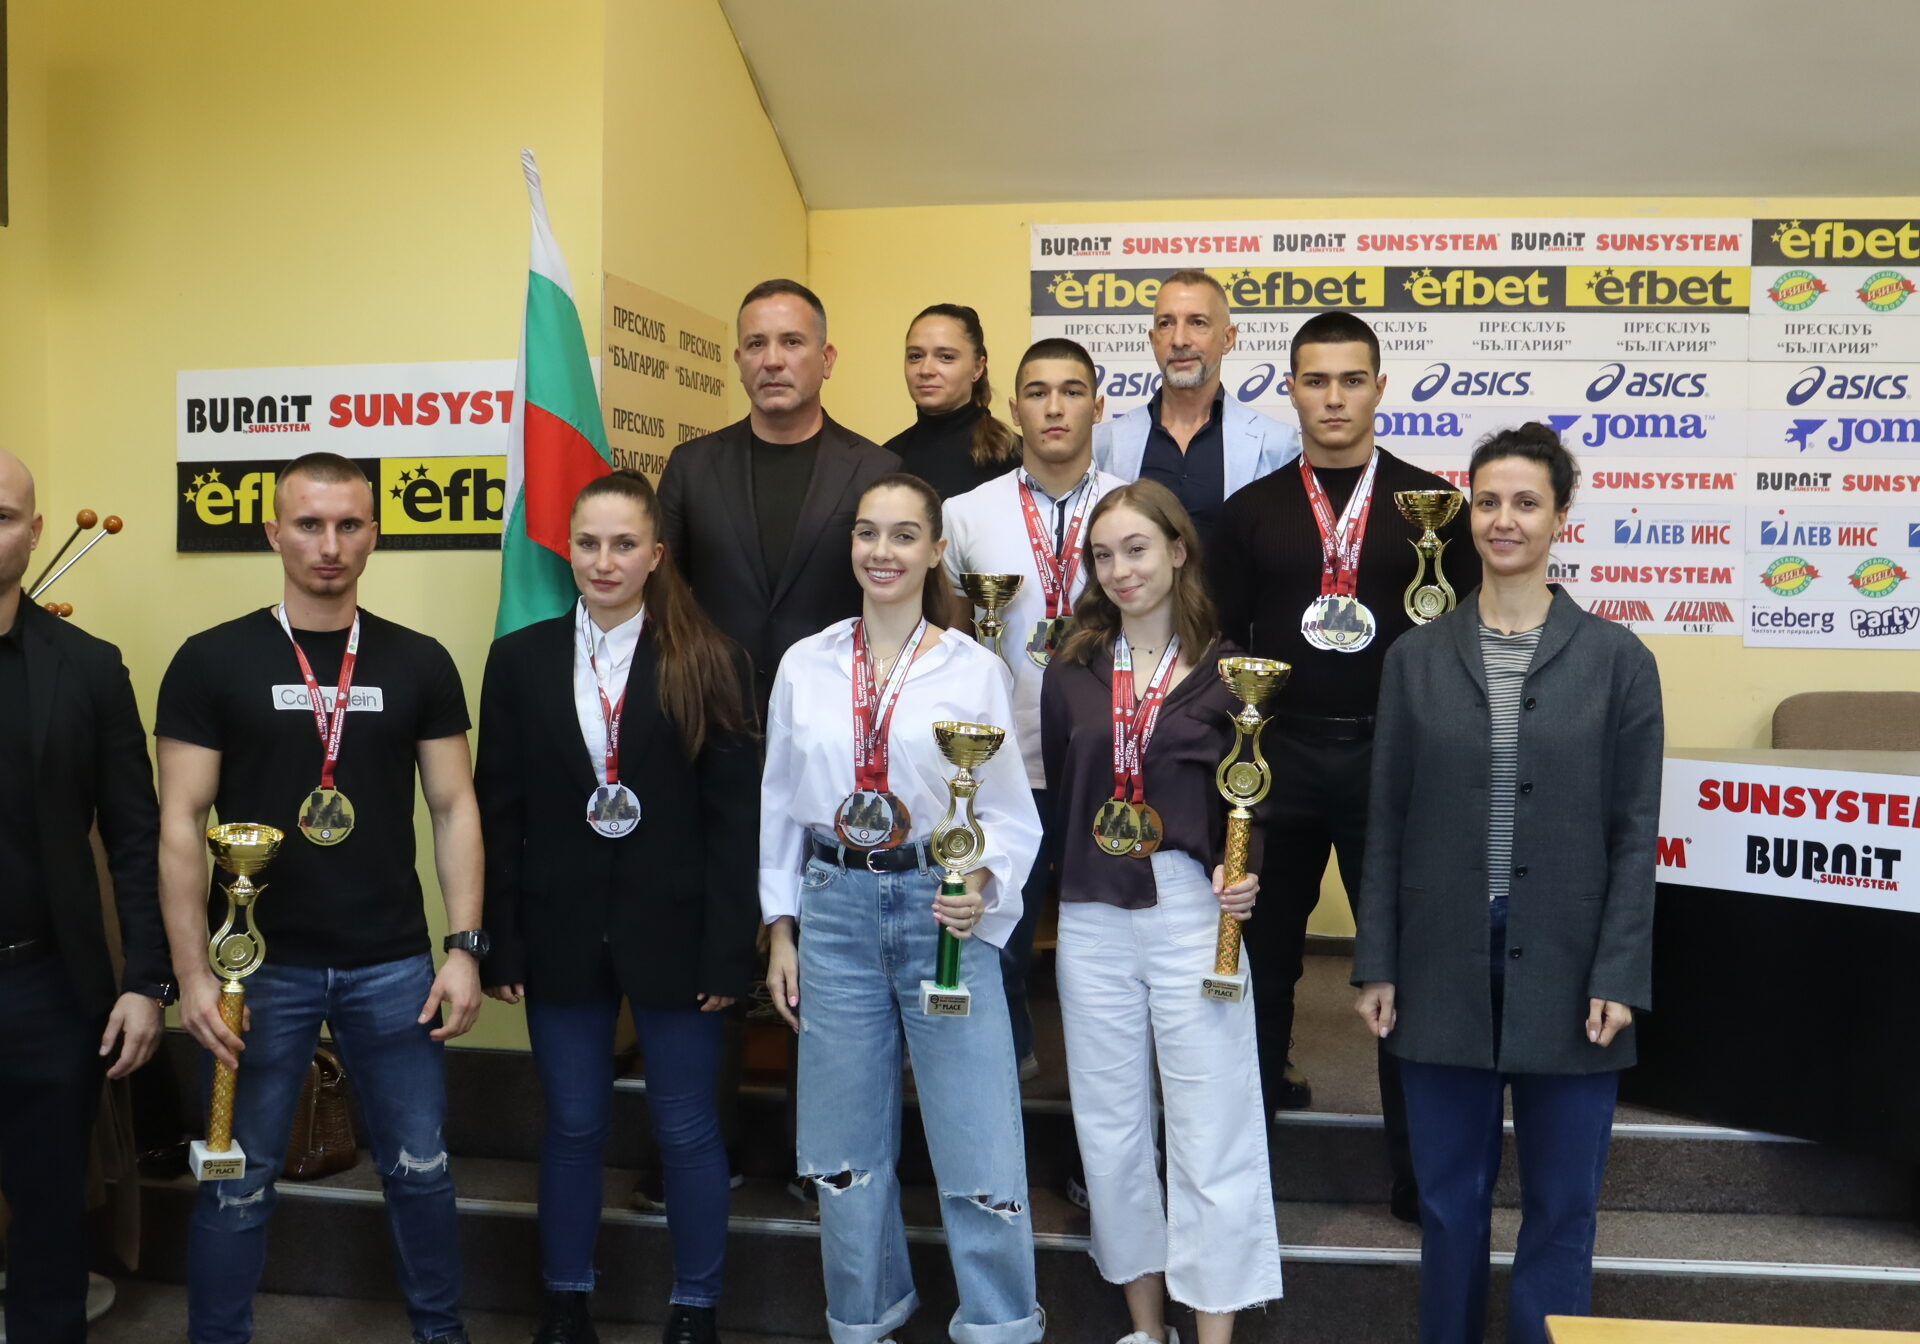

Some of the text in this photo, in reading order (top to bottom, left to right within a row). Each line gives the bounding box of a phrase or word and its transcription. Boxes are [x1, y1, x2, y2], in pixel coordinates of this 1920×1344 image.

[1122, 236, 1260, 254] SUNSYSTEM
[1357, 233, 1498, 252] SUNSYSTEM
[1596, 233, 1739, 252] SUNSYSTEM
[1780, 221, 1920, 259] efbet
[1055, 269, 1732, 309] efbe efbet efbet efbet
[613, 306, 666, 343] ПРЕСКЛУБ
[1064, 323, 1147, 335] ПРЕСКЛУБ
[1236, 321, 1289, 333] СКЛУБ
[1372, 321, 1427, 332] СКЛУБ
[1480, 321, 1566, 333] ПРЕСКЛУБ
[1624, 322, 1710, 333] ПРЕСКЛУБ
[1785, 323, 1872, 335] ПРЕСКЛУБ
[679, 330, 721, 363] ПРЕСКЛУБ
[1106, 372, 1162, 397] asic
[328, 390, 514, 428] SUNSYST
[248, 423, 311, 433] SUNSYSTEM
[613, 407, 665, 438] ПРЕСКЛУБ
[1373, 411, 1464, 437] oma
[1582, 413, 1707, 447] Joma
[1828, 418, 1920, 452] Jom
[1592, 472, 1734, 490] SUNSYSTEM
[1842, 474, 1920, 492] SUNSY
[402, 468, 506, 522] efb
[1555, 524, 1585, 543] НС
[1646, 525, 1731, 545] ЛЕВ ИНС
[1792, 526, 1878, 547] ЛЕВ ИНС
[1590, 565, 1733, 584] SUNSYSTEM
[1751, 606, 1835, 633] iceberg
[1851, 606, 1920, 630] Party
[1859, 625, 1906, 638] DRINKS
[348, 692, 377, 707] lein
[1698, 778, 1920, 828] SUNSYSTE
[1819, 873, 1898, 891] SUNSYSTEM
